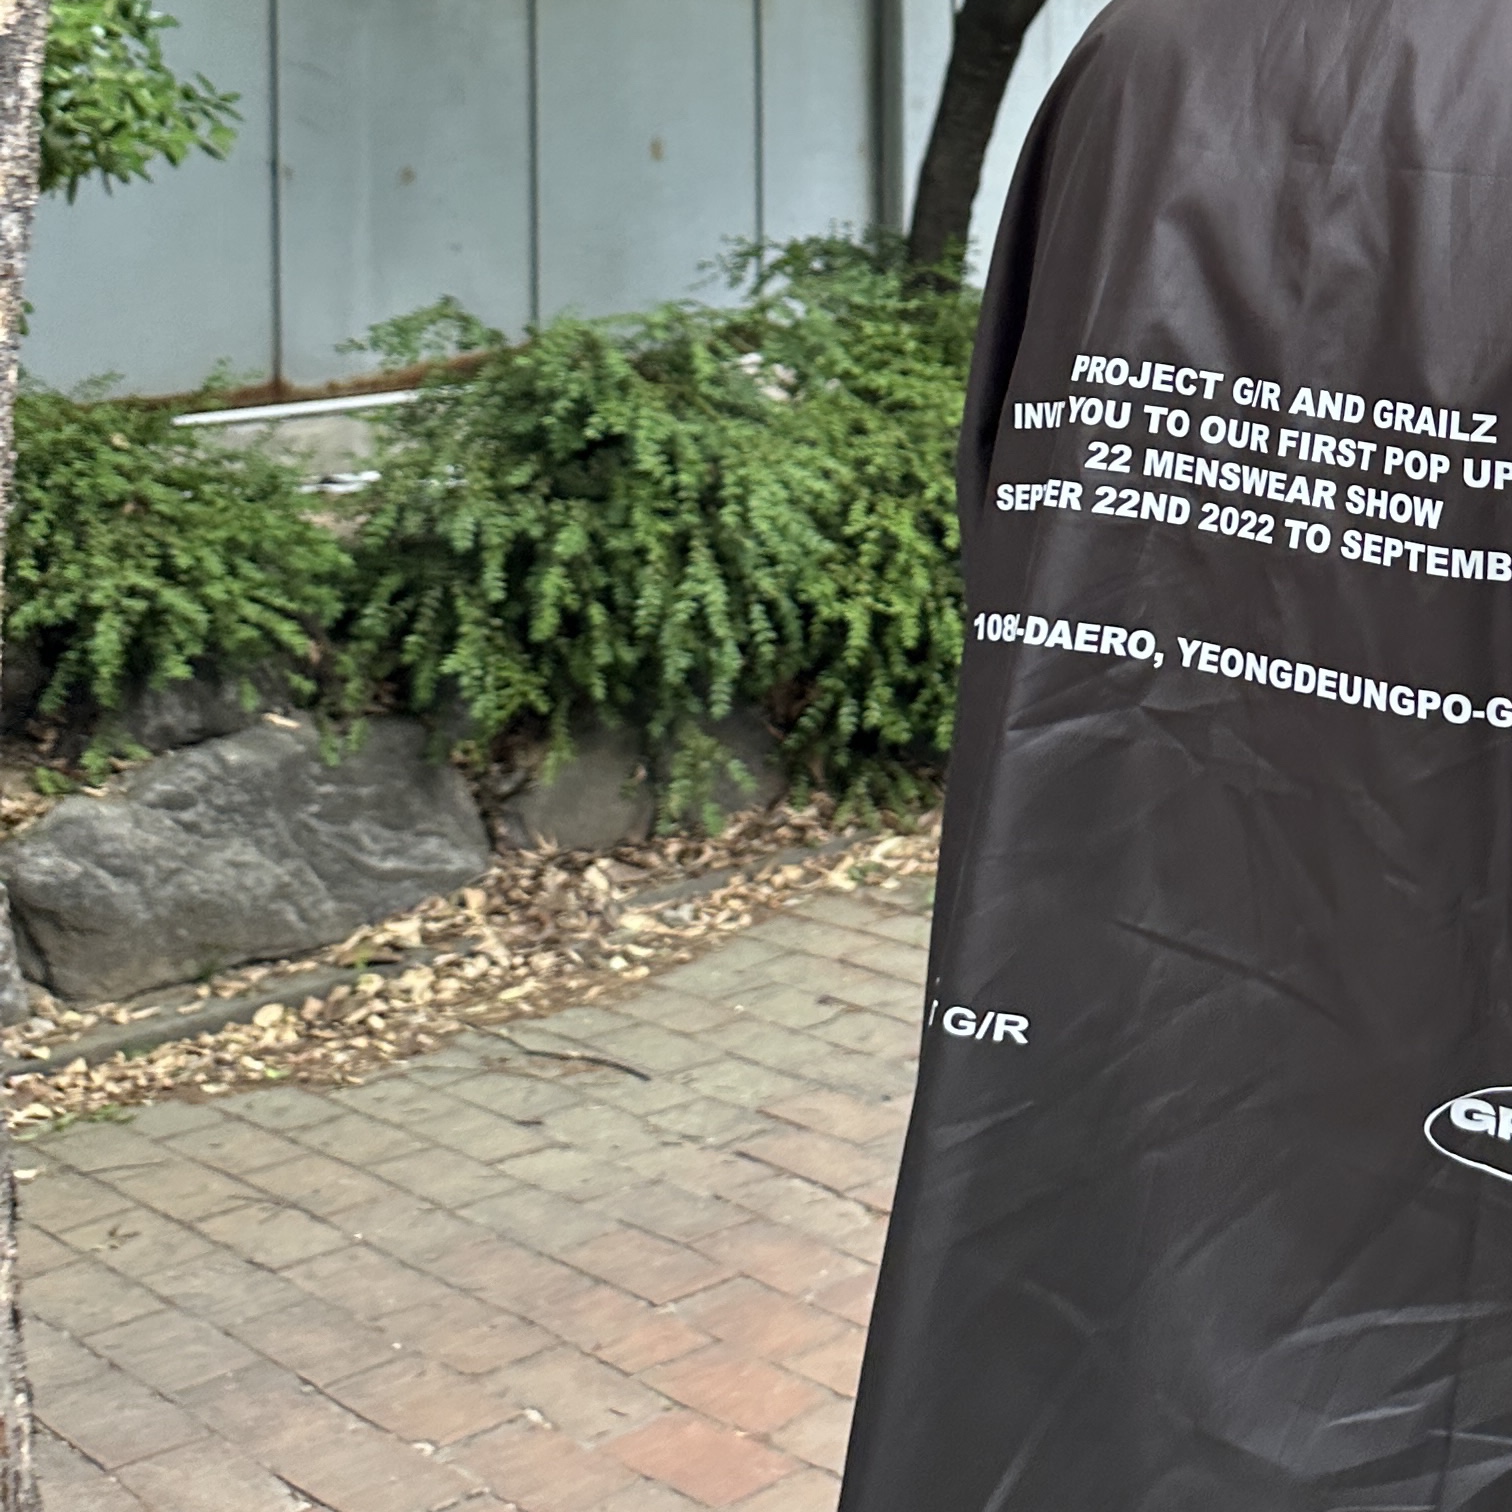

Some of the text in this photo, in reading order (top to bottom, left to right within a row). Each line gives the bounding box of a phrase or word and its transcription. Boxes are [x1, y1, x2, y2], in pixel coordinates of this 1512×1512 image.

[1068, 395, 1132, 430] YOU
[1143, 404, 1190, 438] TO
[1200, 415, 1271, 455] OUR
[1277, 428, 1378, 472] FIRST
[1383, 445, 1451, 484] POP
[1070, 354, 1498, 444] PROJECT G/R AND GRAILZ
[1084, 441, 1444, 530] 22 MENSWEAR SHOW
[1091, 485, 1191, 525] 22ND
[1197, 502, 1276, 544] 2022
[1284, 518, 1331, 554] TO
[942, 1005, 1030, 1044] G/R
